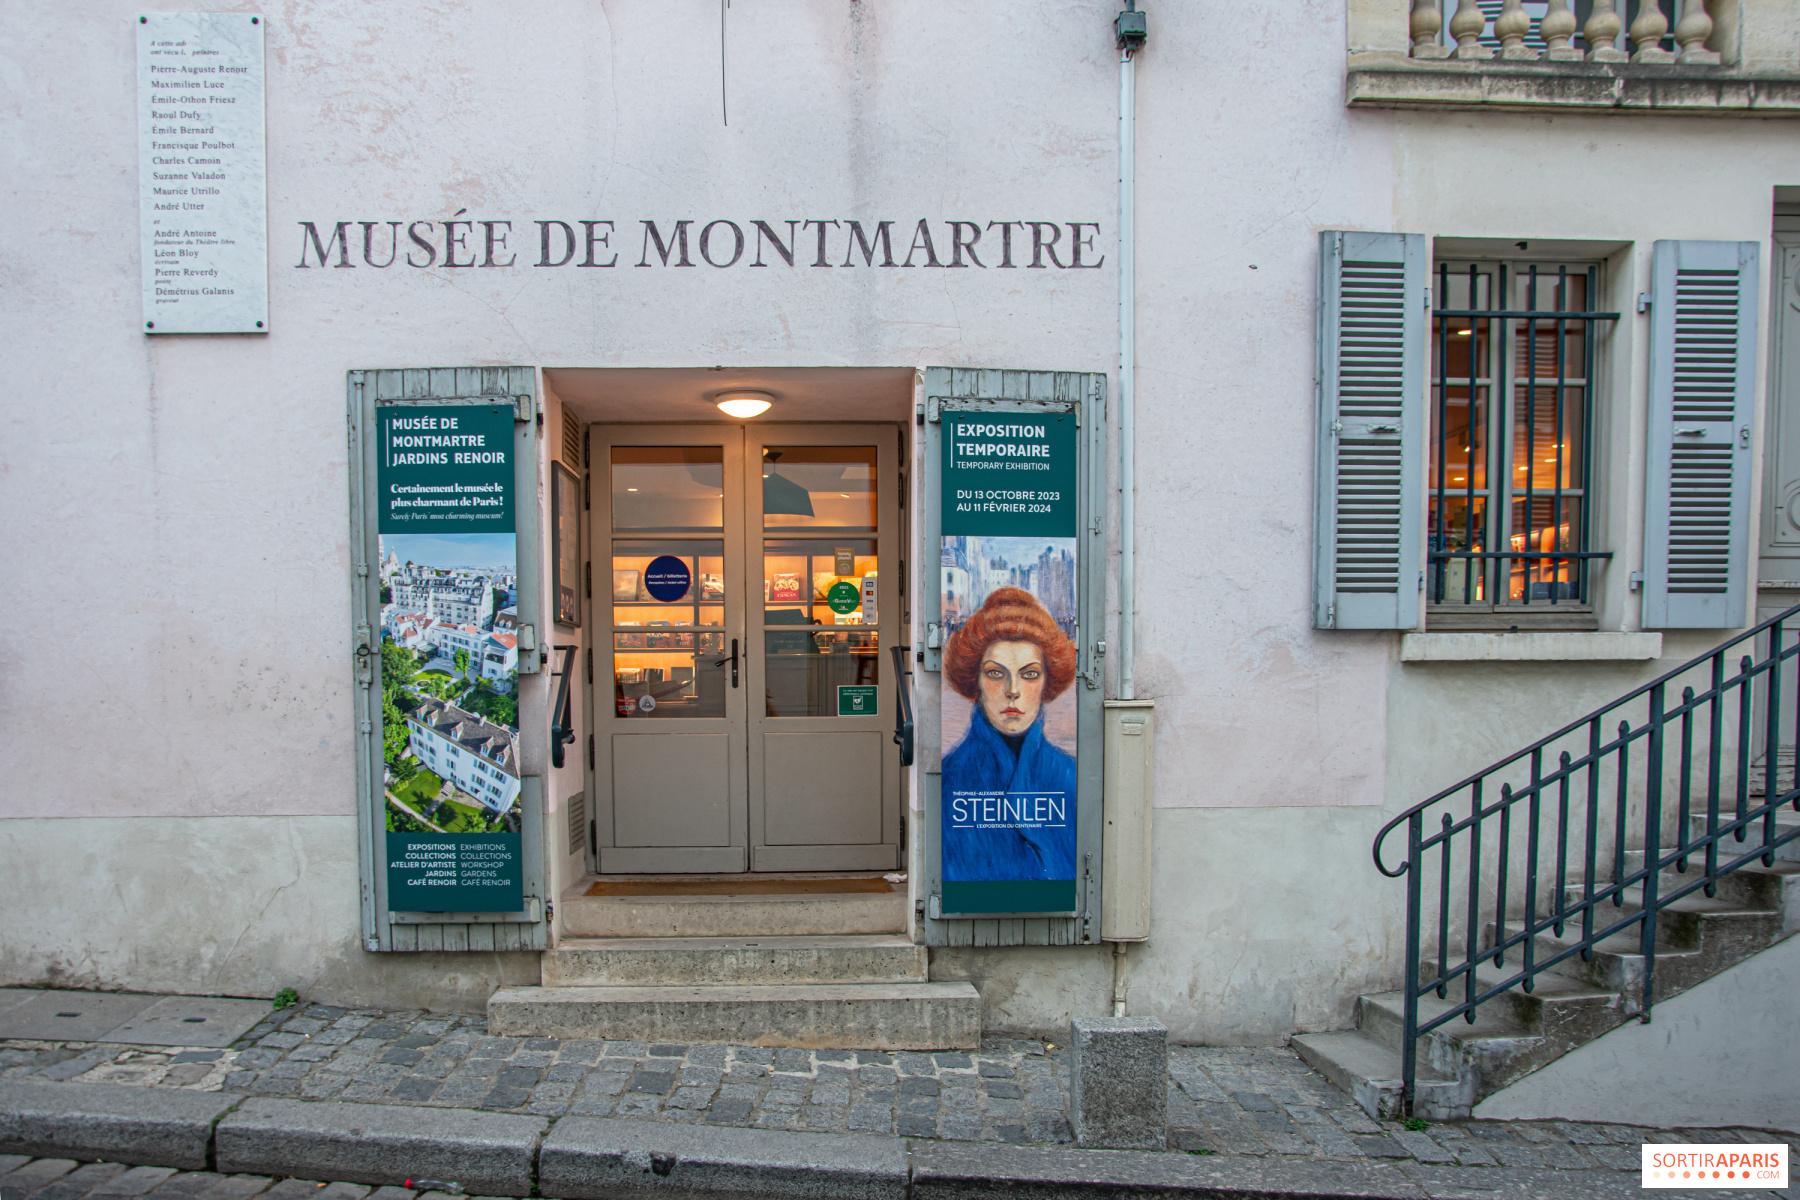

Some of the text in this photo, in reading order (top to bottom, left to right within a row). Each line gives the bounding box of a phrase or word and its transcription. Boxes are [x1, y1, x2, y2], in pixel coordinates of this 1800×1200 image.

[151, 66, 248, 74] Pierre-Auguste Renoir
[151, 80, 224, 88] Maximilien Luce
[210, 96, 236, 104] Friesz
[152, 111, 200, 120] Raoul Dufy
[180, 126, 214, 134] Bernard
[152, 142, 235, 151] Francisque Poulbot
[152, 156, 221, 164] Charles Camoin
[153, 172, 226, 180] Suzanne Valadon
[192, 187, 220, 195] Utrillo
[154, 202, 204, 210] André Utter
[154, 230, 217, 238] André Antoine
[294, 208, 1106, 270] MUSÉE DE MONTMARTRE
[154, 249, 200, 258] Léon Bloy
[155, 268, 218, 278] Pierre Reverdy
[156, 287, 234, 296] Démétrius Galanis
[392, 416, 458, 430] MUSÉE DE
[956, 424, 1046, 438] EXPOSITION
[392, 434, 486, 448] MONTMARTRE
[956, 443, 1050, 458] TEMPORAIRE
[392, 452, 506, 467] JARDINS RENOIR
[956, 461, 1050, 471] TEMPORARY EXHIBITION
[390, 482, 504, 494] Certainement le musée le
[956, 490, 1060, 500] DU 13 OCTOBRE 2023
[390, 497, 412, 510] plus
[412, 496, 459, 507] charmant
[460, 496, 472, 507] de
[956, 501, 1051, 512] AU 11 FÉVRIER 2024
[390, 512, 409, 522] Surely
[445, 512, 474, 521] charming
[952, 798, 1066, 822] STEINLEN
[462, 878, 480, 886] CAFÉ
